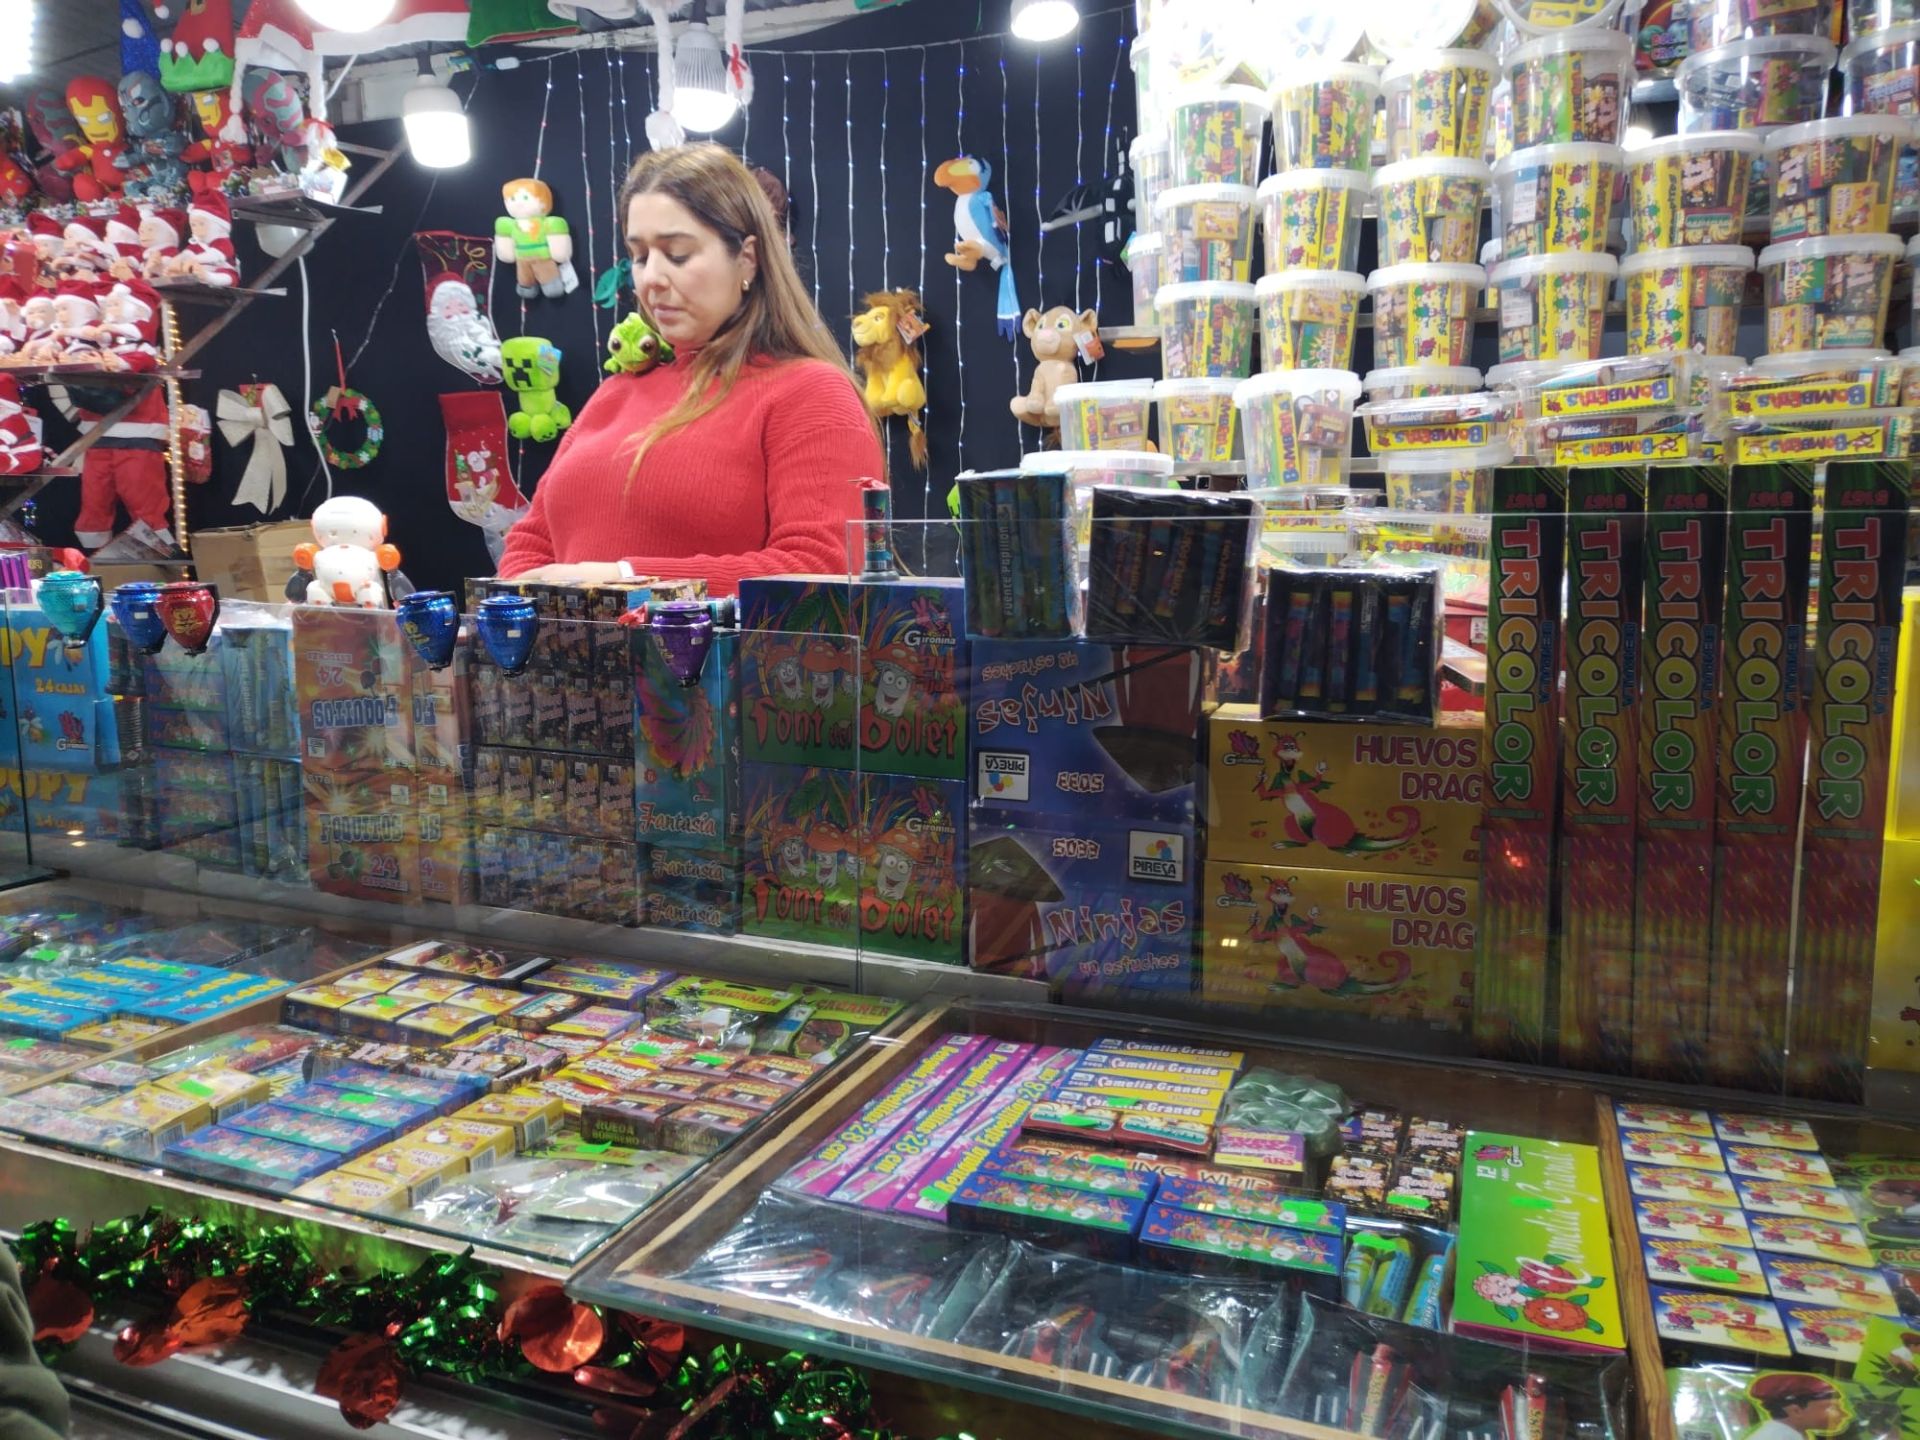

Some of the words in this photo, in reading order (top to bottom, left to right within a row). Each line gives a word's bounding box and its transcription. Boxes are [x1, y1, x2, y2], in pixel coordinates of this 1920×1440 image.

[1567, 378, 1669, 405] BOMBETAS
[1758, 385, 1866, 407] BOMBETAS
[1395, 424, 1483, 443] BOMBETAS
[904, 630, 957, 647] Gironina
[1493, 519, 1541, 801] TRICOLOR
[1576, 519, 1621, 807] TRICOLOR
[1652, 519, 1701, 812] TRICOLOR
[1731, 518, 1787, 815] TRICOLOR
[1818, 517, 1880, 820] TRICOLOR
[317, 667, 345, 687] 24
[311, 698, 398, 729] FOQUITOS
[976, 682, 1112, 734] Ninjas
[1354, 734, 1480, 768] HUEVOS
[985, 757, 1025, 771] PIRESA
[1056, 771, 1104, 793] 5033
[320, 814, 403, 843] FOQUITOS
[905, 817, 956, 835] Gironina
[1053, 838, 1100, 860] 5033
[370, 855, 399, 878] 24
[1134, 860, 1176, 875] PIRESA
[1347, 881, 1468, 917] HUEVOS
[1047, 899, 1185, 950] Ninjas
[1391, 918, 1477, 952] DRAG
[1104, 952, 1180, 976] estuches
[1126, 1041, 1177, 1053] Camelia
[1181, 1045, 1231, 1057] Grande
[1111, 1057, 1164, 1071] Camelia
[1167, 1063, 1219, 1076] Grande
[1097, 1077, 1151, 1091] Camelia
[1154, 1083, 1208, 1095] Grande
[1146, 1102, 1201, 1117] Grande
[1476, 1165, 1497, 1180] 12
